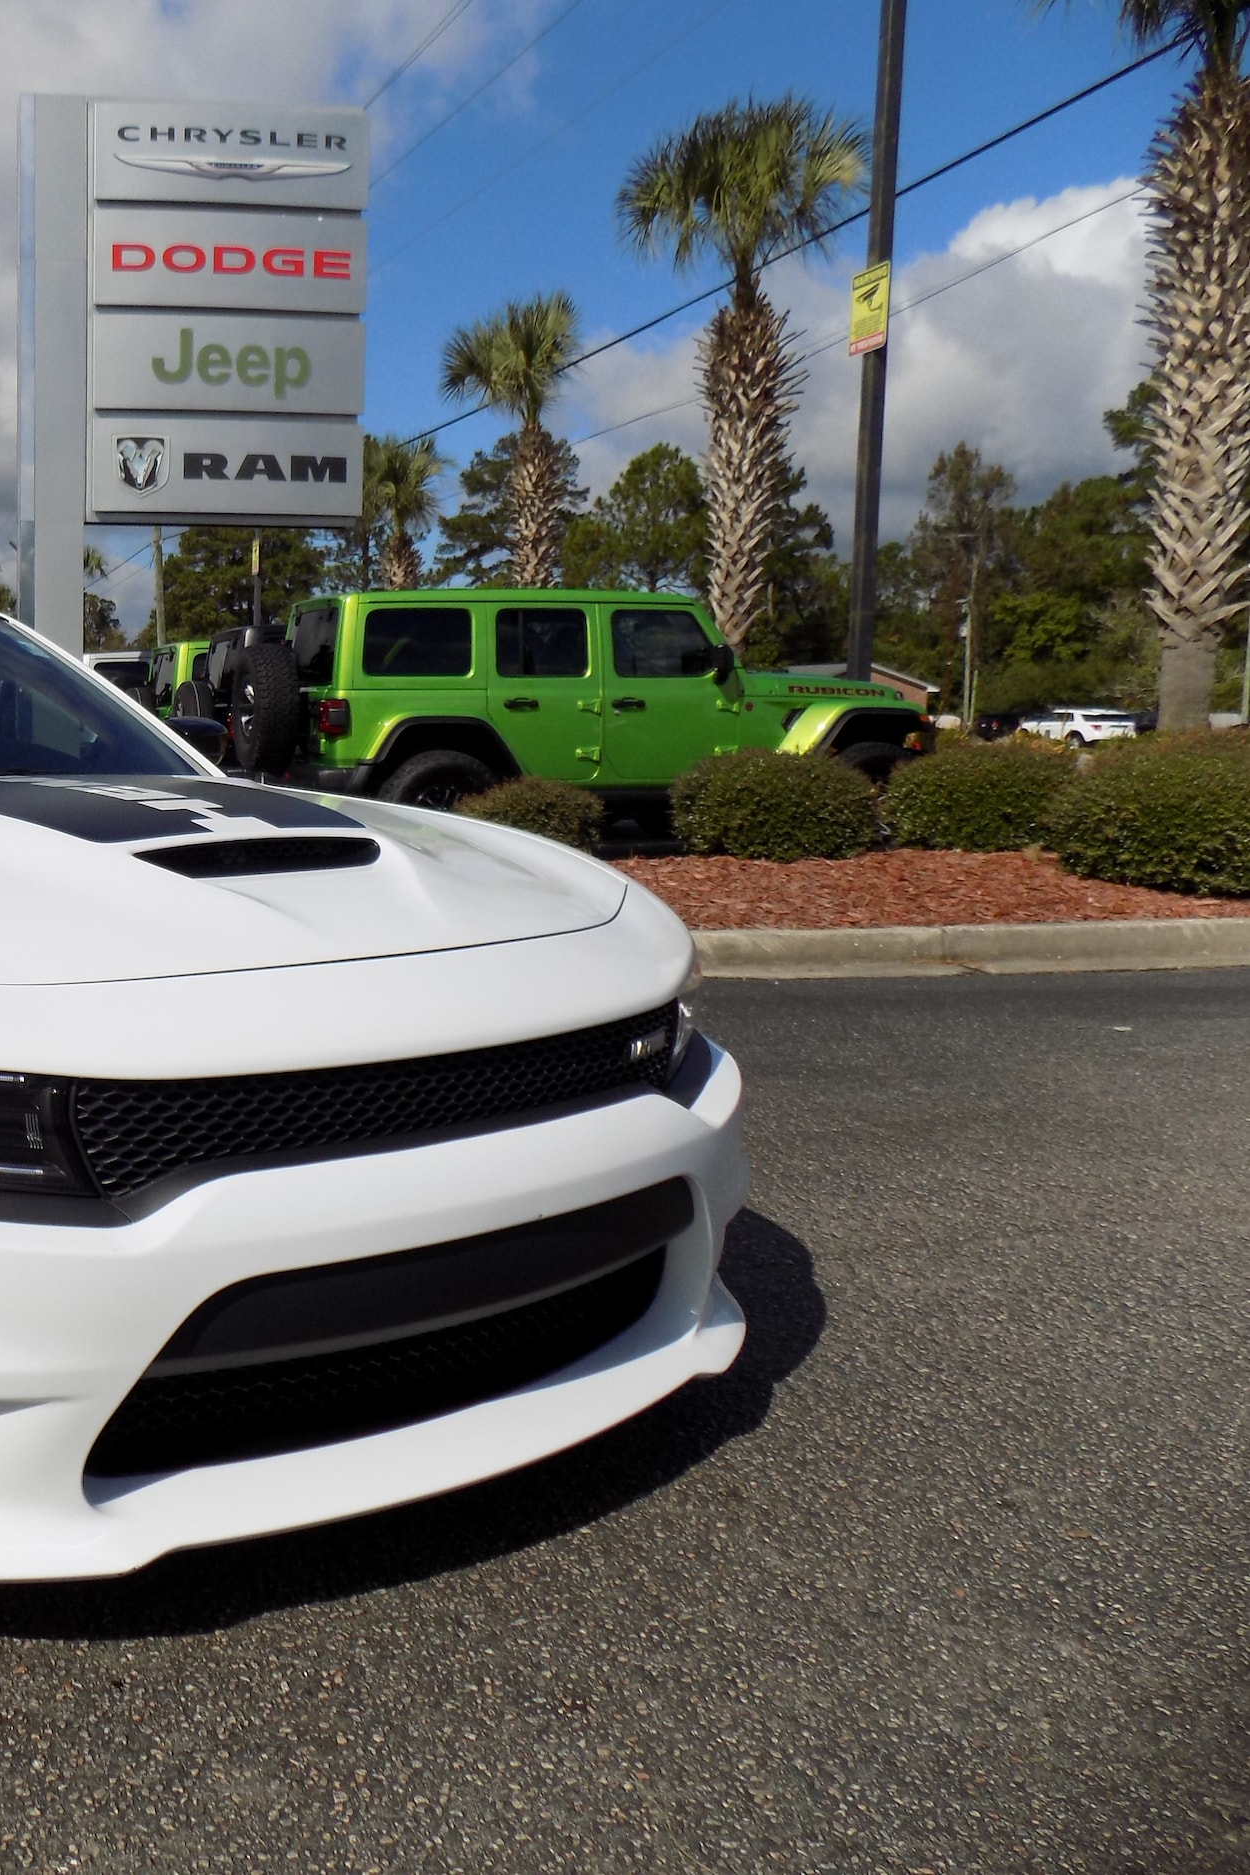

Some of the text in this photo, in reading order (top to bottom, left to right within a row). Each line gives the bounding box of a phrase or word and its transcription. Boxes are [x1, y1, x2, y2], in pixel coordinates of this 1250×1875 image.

[117, 126, 348, 151] CHRYSLER
[112, 243, 351, 279] DODGE
[151, 327, 312, 399] Jeep
[183, 452, 348, 484] RAM
[788, 685, 886, 697] RUBICON
